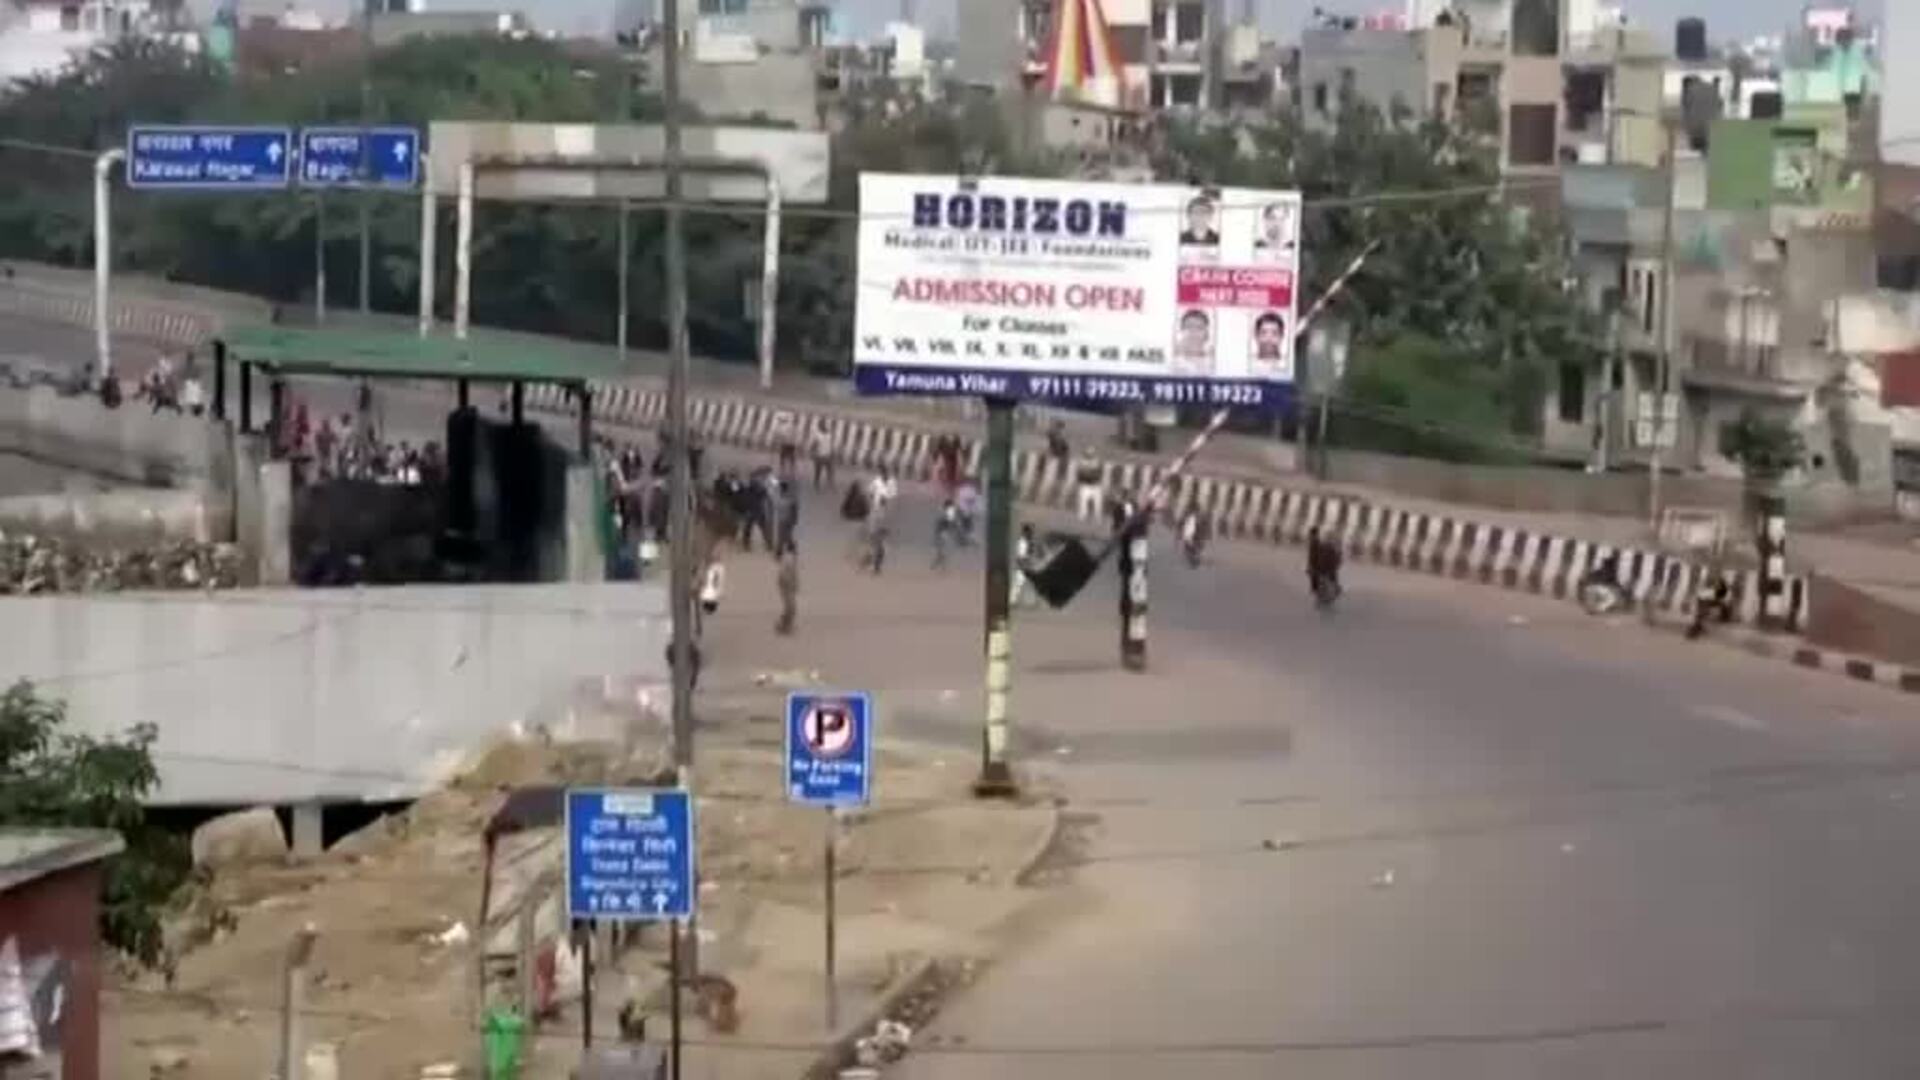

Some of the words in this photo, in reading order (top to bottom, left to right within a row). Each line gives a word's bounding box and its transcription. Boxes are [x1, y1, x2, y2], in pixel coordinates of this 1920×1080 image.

[914, 193, 1126, 236] HORIZON
[885, 233, 953, 250] Medical
[893, 277, 1056, 307] ADMISSION
[1065, 284, 1144, 312] OPEN
[963, 315, 990, 331] For
[999, 316, 1068, 335] Classes
[885, 371, 956, 391] Yamuna
[960, 373, 1007, 393] Vihar
[1030, 376, 1081, 396] 97111
[1154, 382, 1204, 402] 98111
